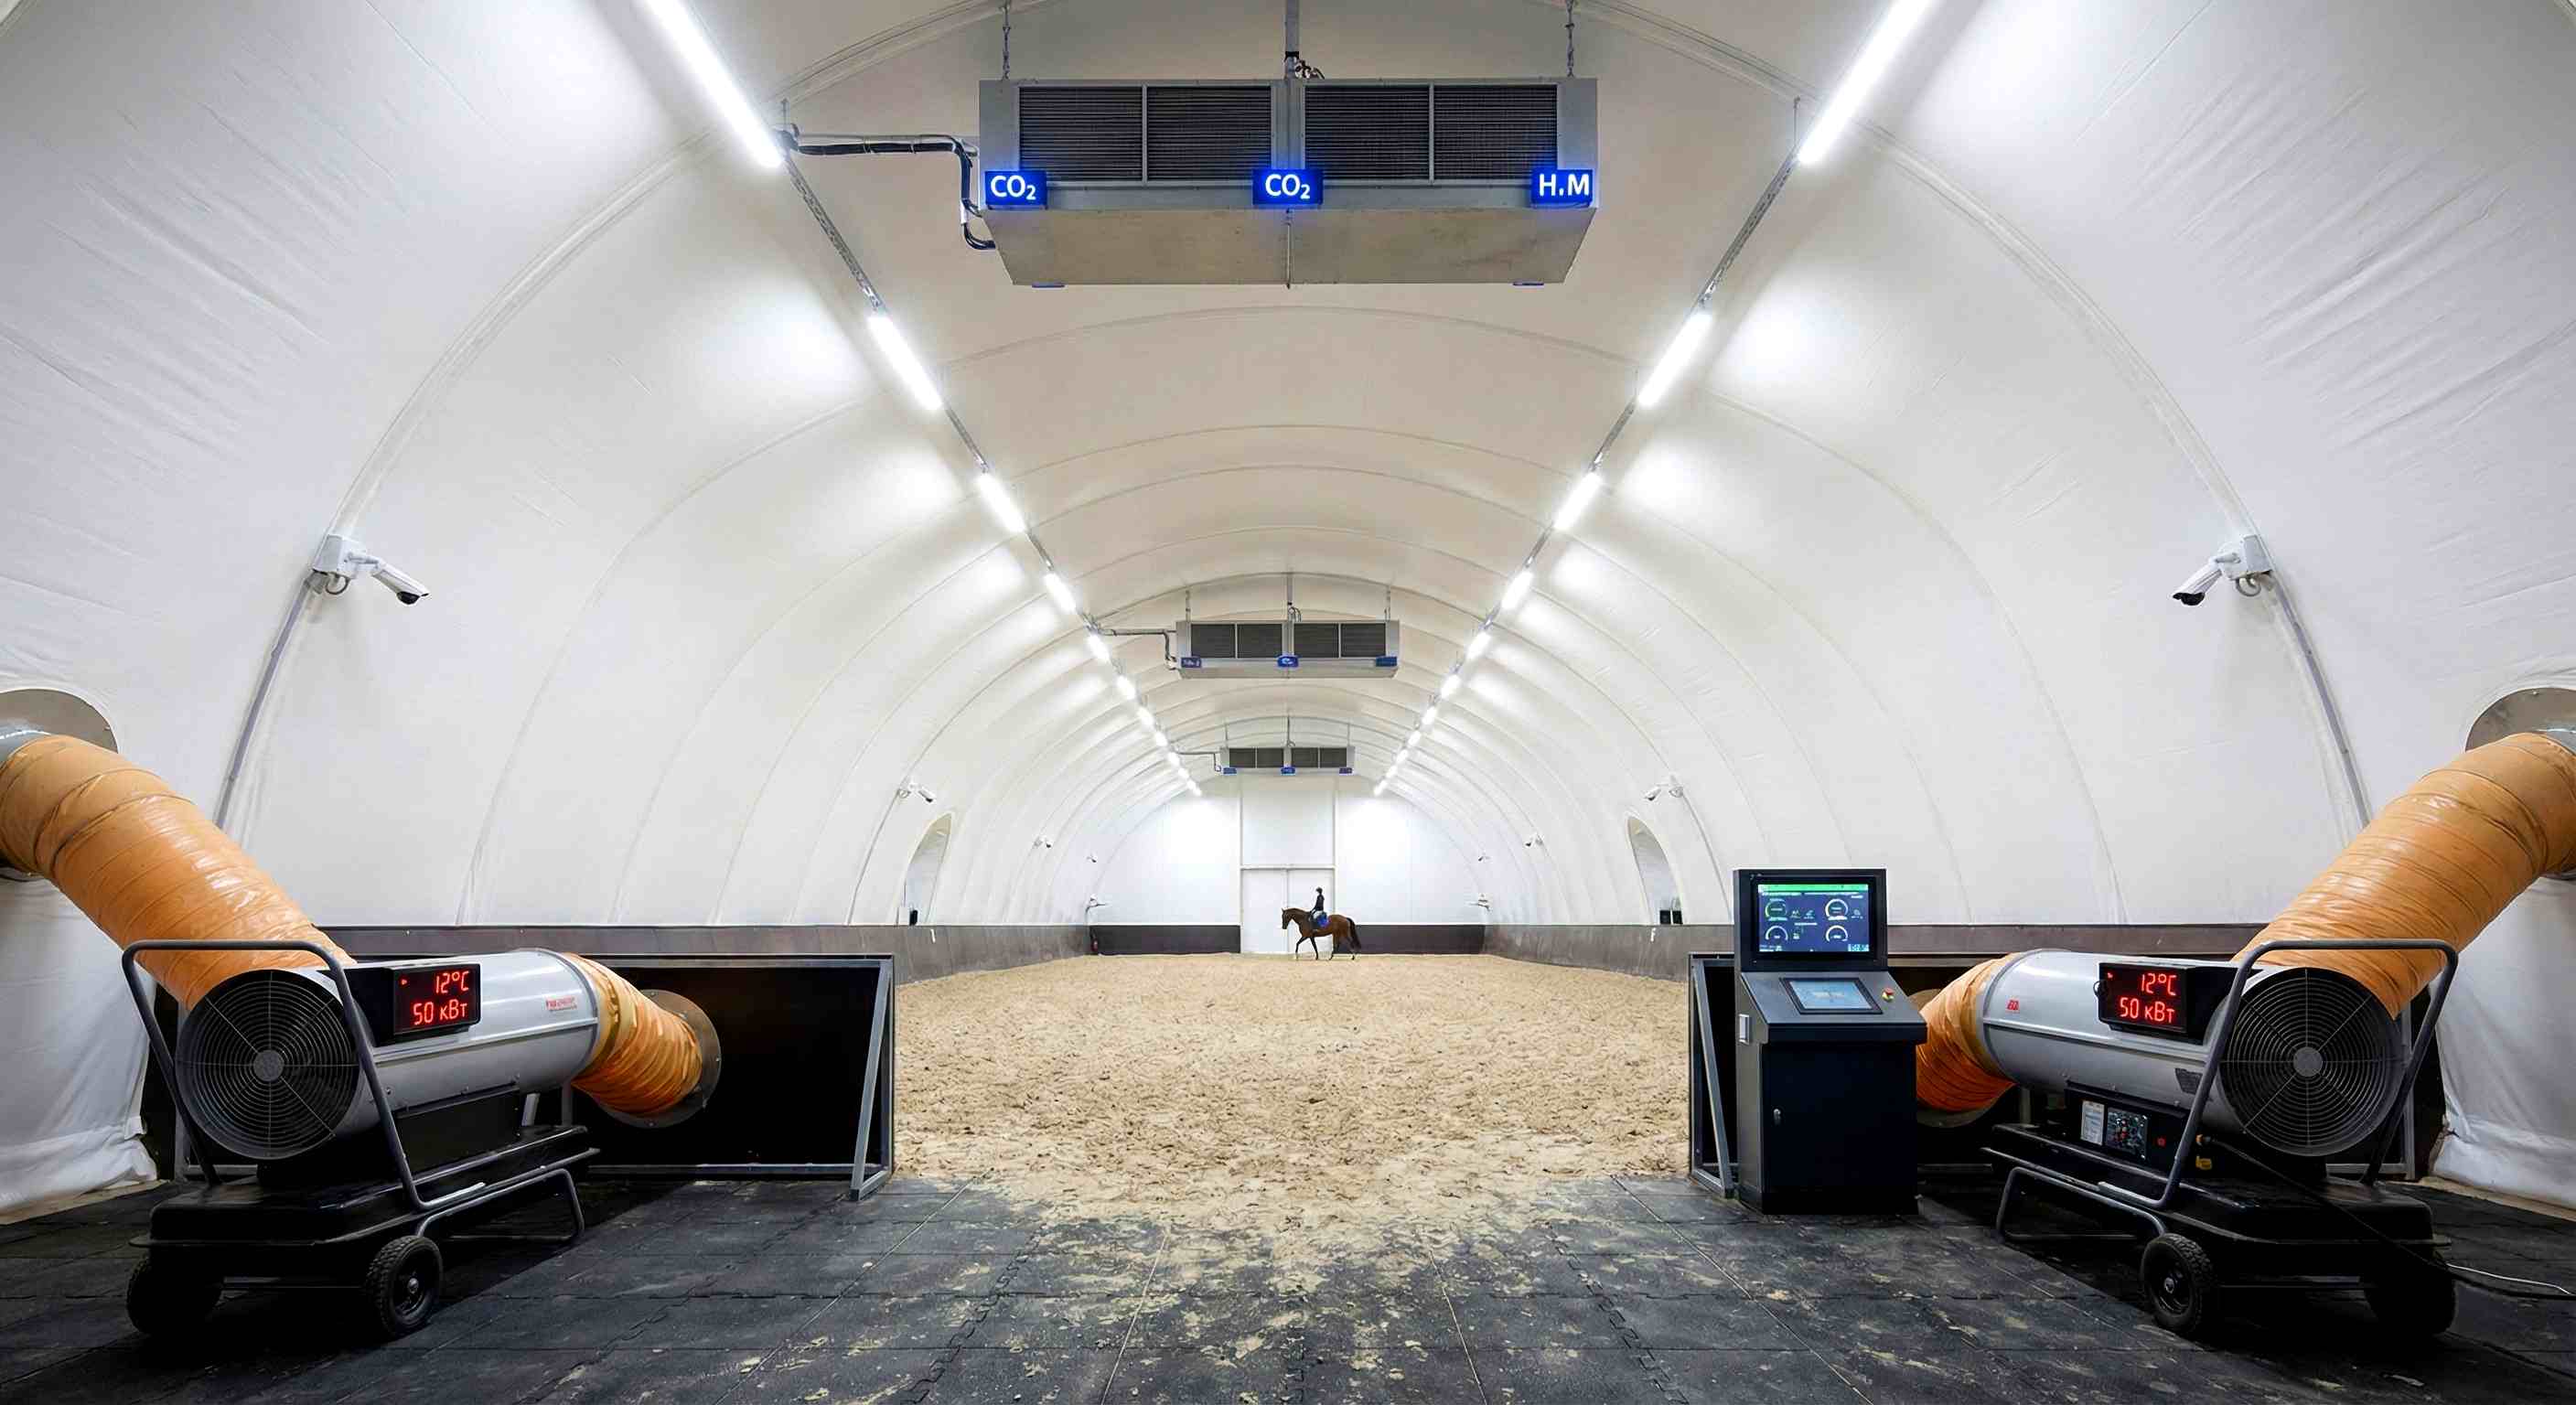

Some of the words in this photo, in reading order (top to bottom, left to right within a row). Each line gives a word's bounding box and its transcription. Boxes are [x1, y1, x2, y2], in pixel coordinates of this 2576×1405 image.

[1539, 173, 1590, 197] H.M
[435, 971, 469, 994] 12°C
[2141, 972, 2177, 996] 12°C
[413, 1002, 435, 1025] 50
[439, 998, 468, 1021] кВт
[2120, 996, 2140, 1019] 50
[2144, 1001, 2175, 1024] кВт
